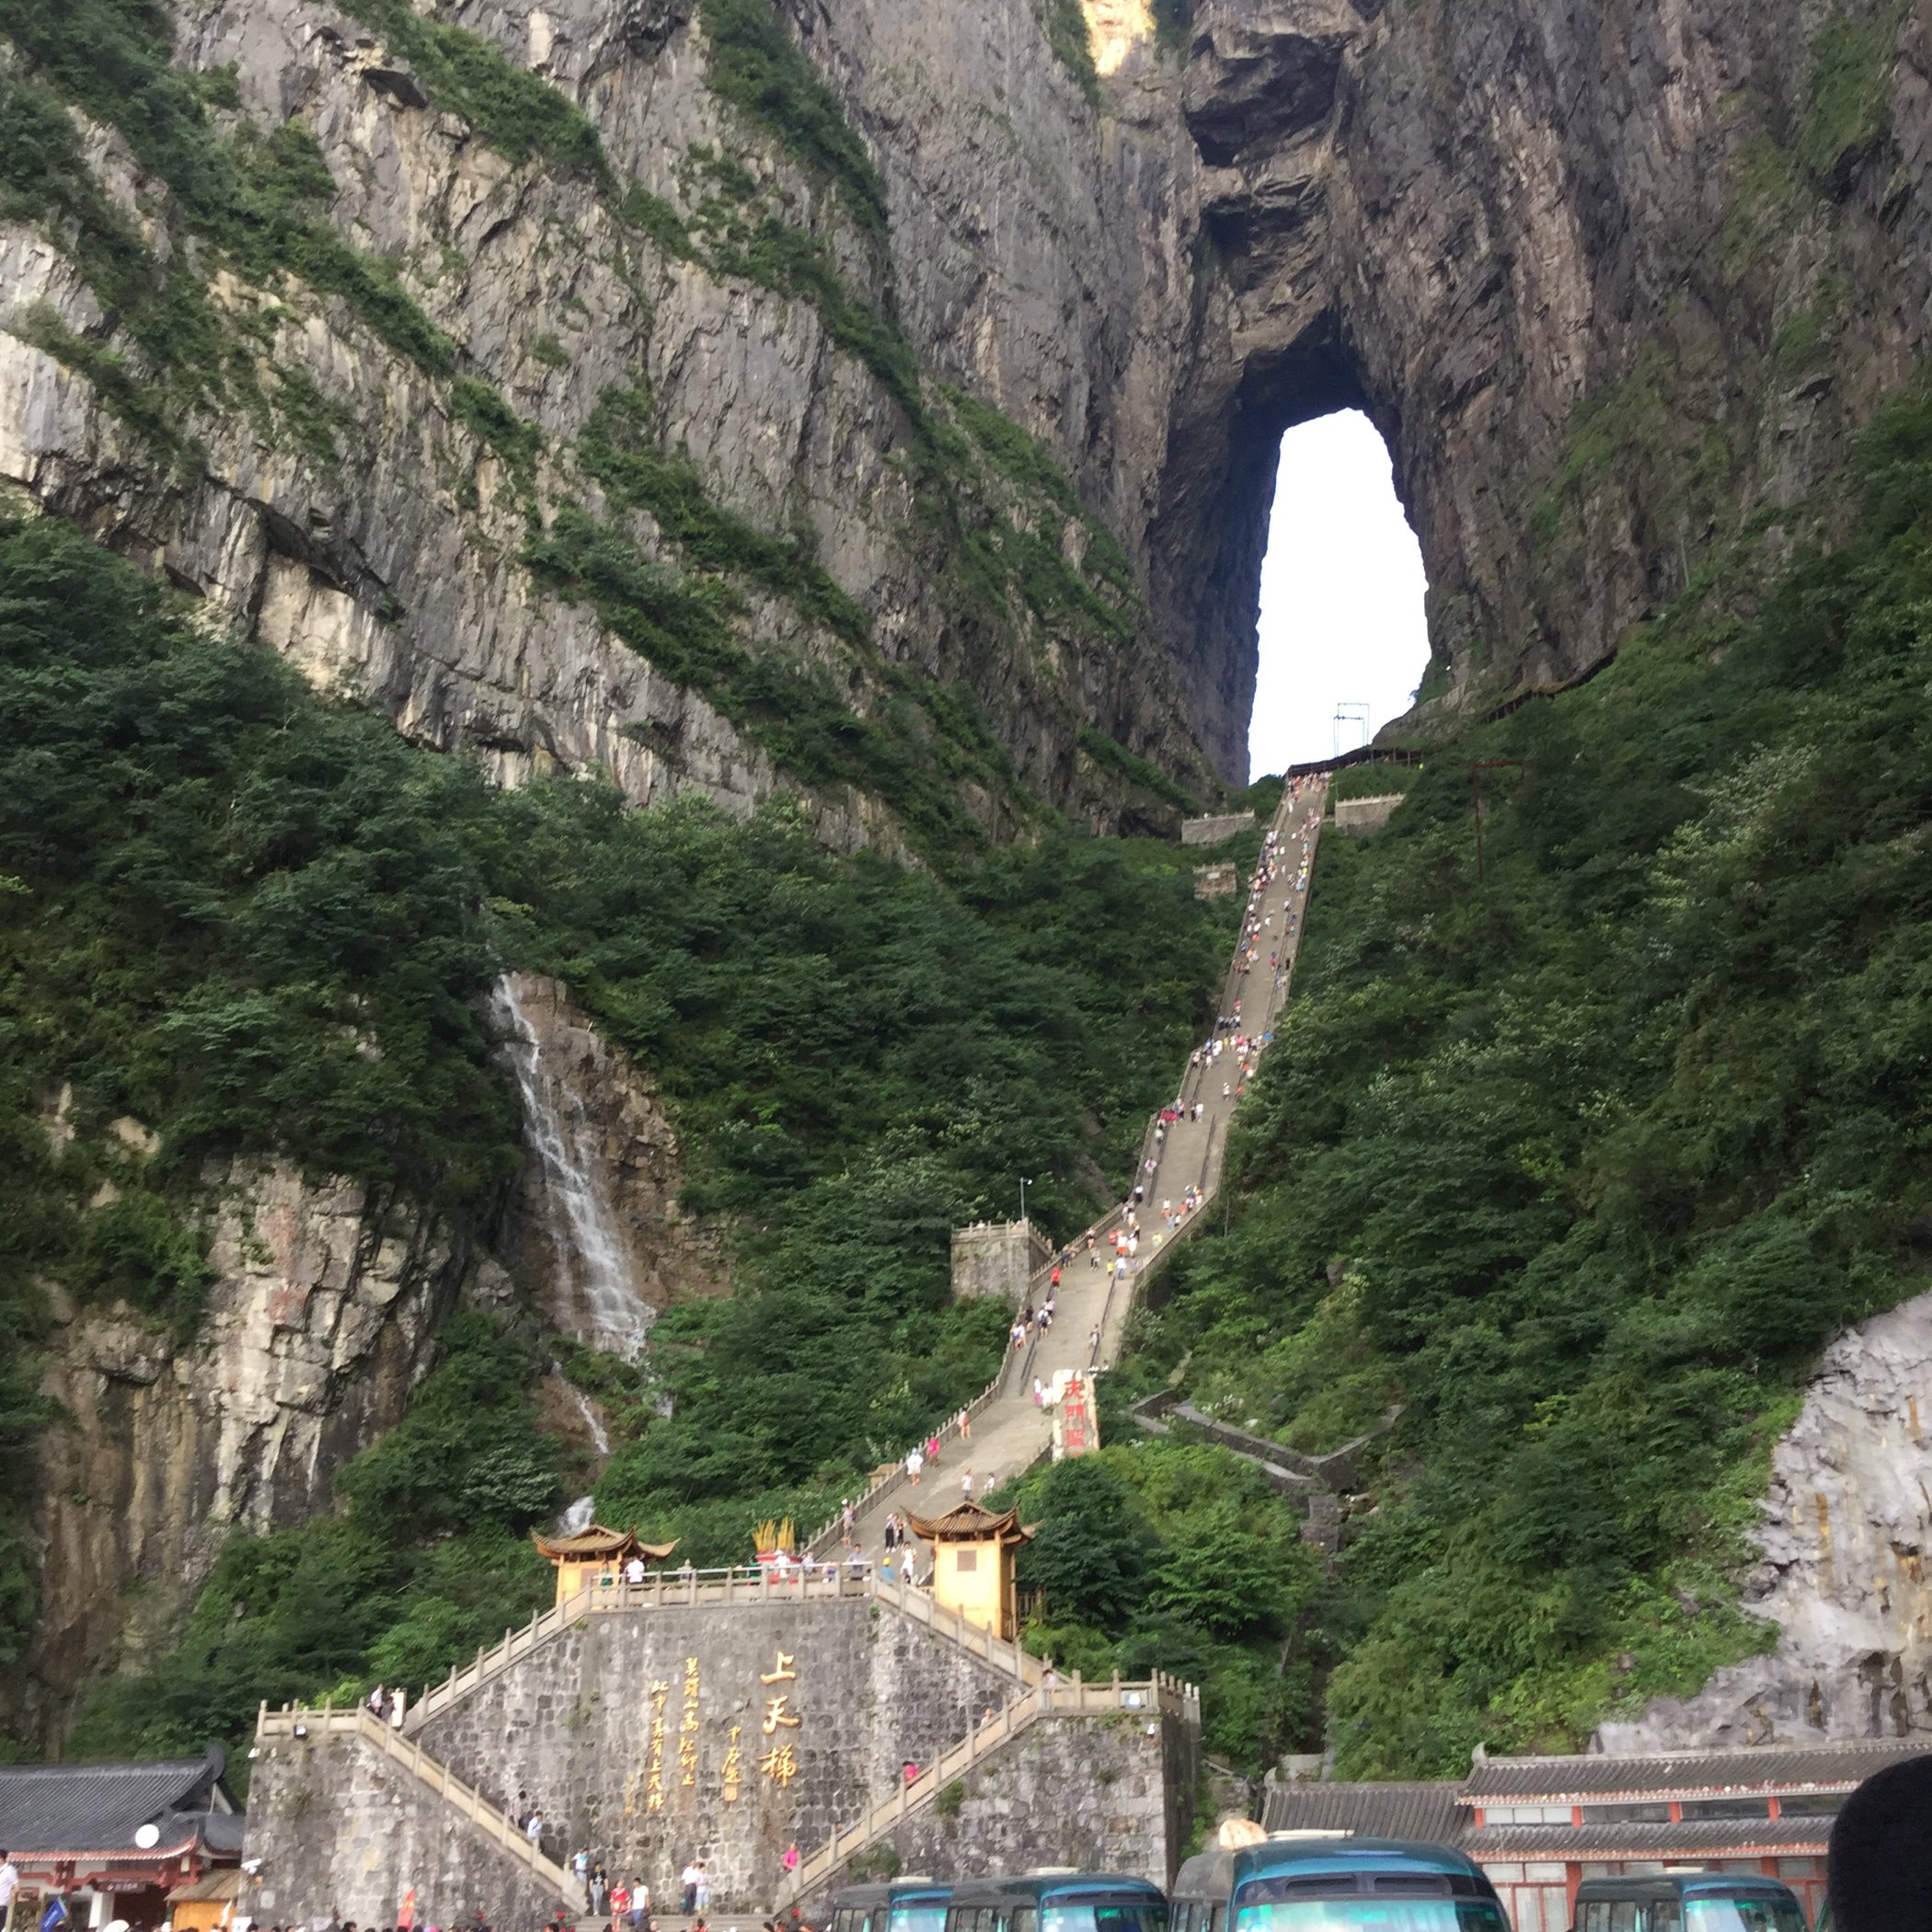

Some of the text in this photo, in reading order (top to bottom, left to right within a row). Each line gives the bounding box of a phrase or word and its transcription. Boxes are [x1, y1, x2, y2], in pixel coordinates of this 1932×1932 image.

[1064, 1378, 1086, 1457] 天門聖
[758, 1650, 801, 1788] 上天梯
